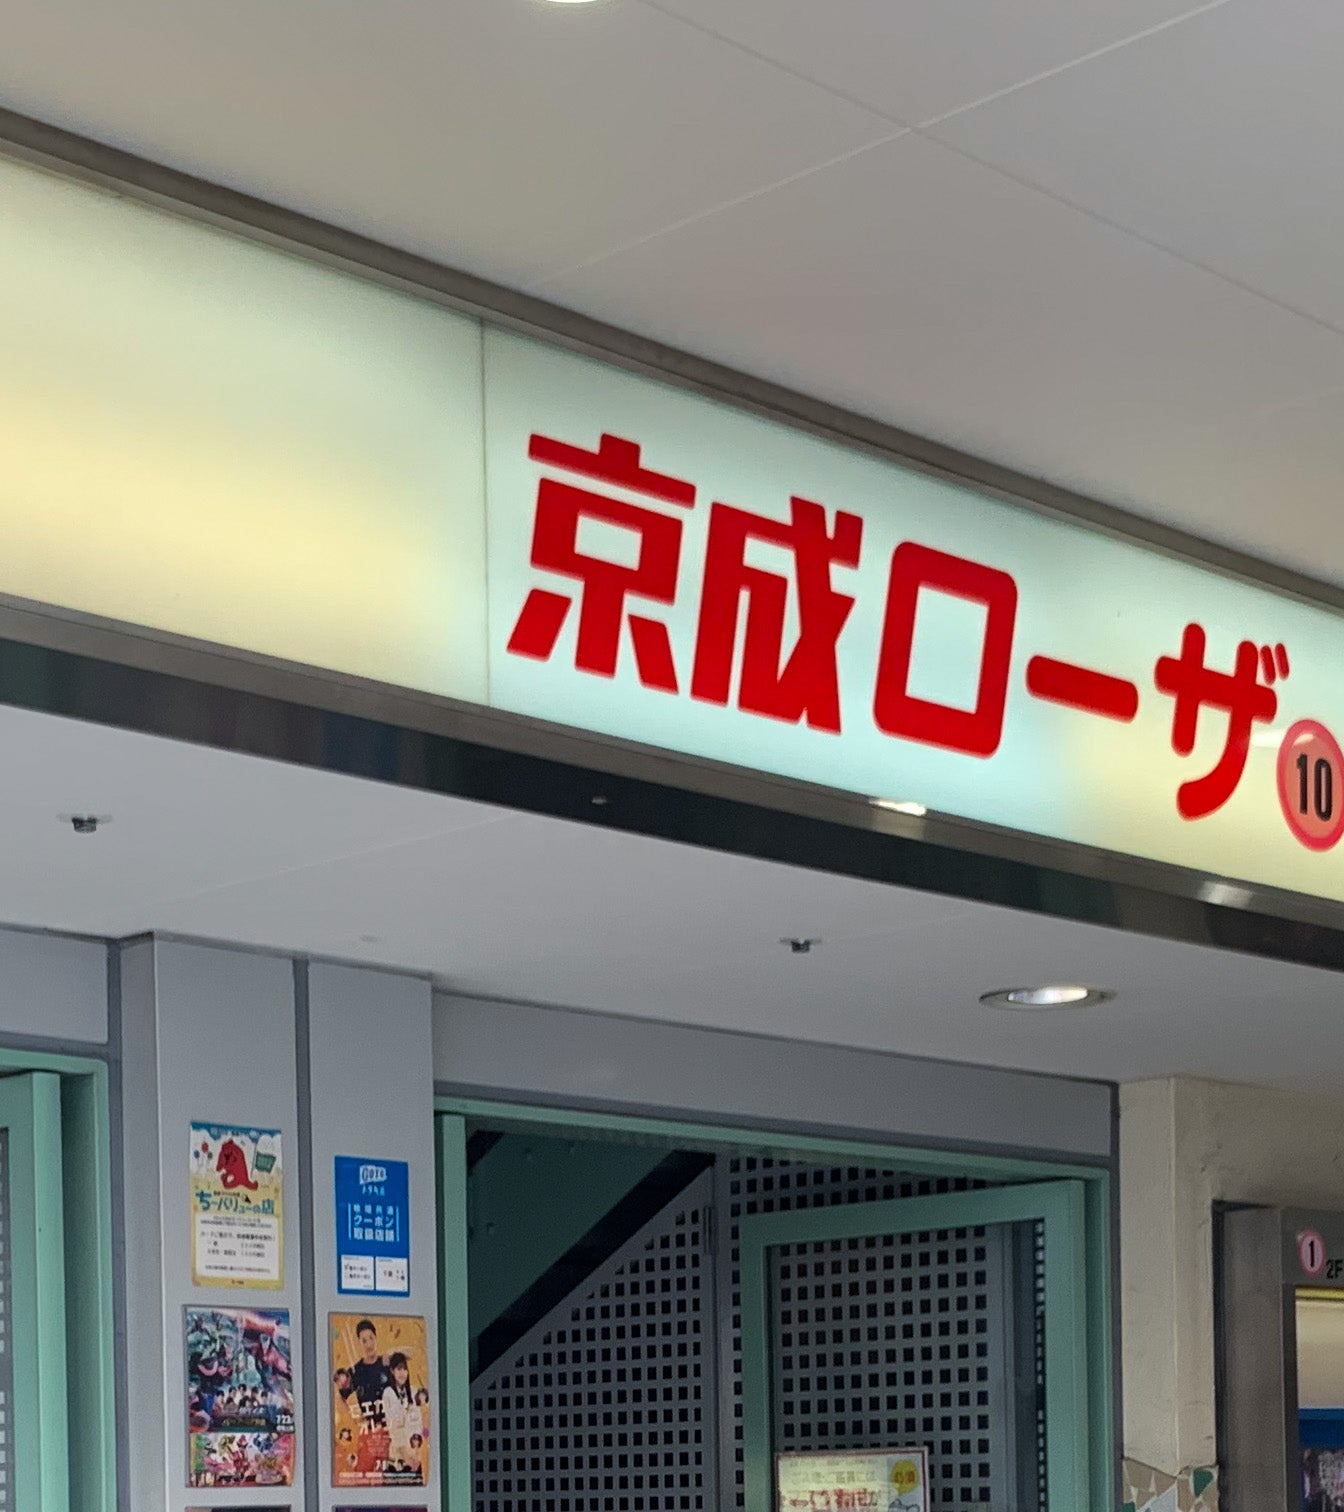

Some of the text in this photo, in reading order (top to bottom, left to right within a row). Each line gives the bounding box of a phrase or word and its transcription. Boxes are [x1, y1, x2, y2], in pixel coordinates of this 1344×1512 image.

[507, 434, 1289, 820] 京成ローザ
[353, 1214, 394, 1228] クーポン
[1326, 1259, 1343, 1279] 2F
